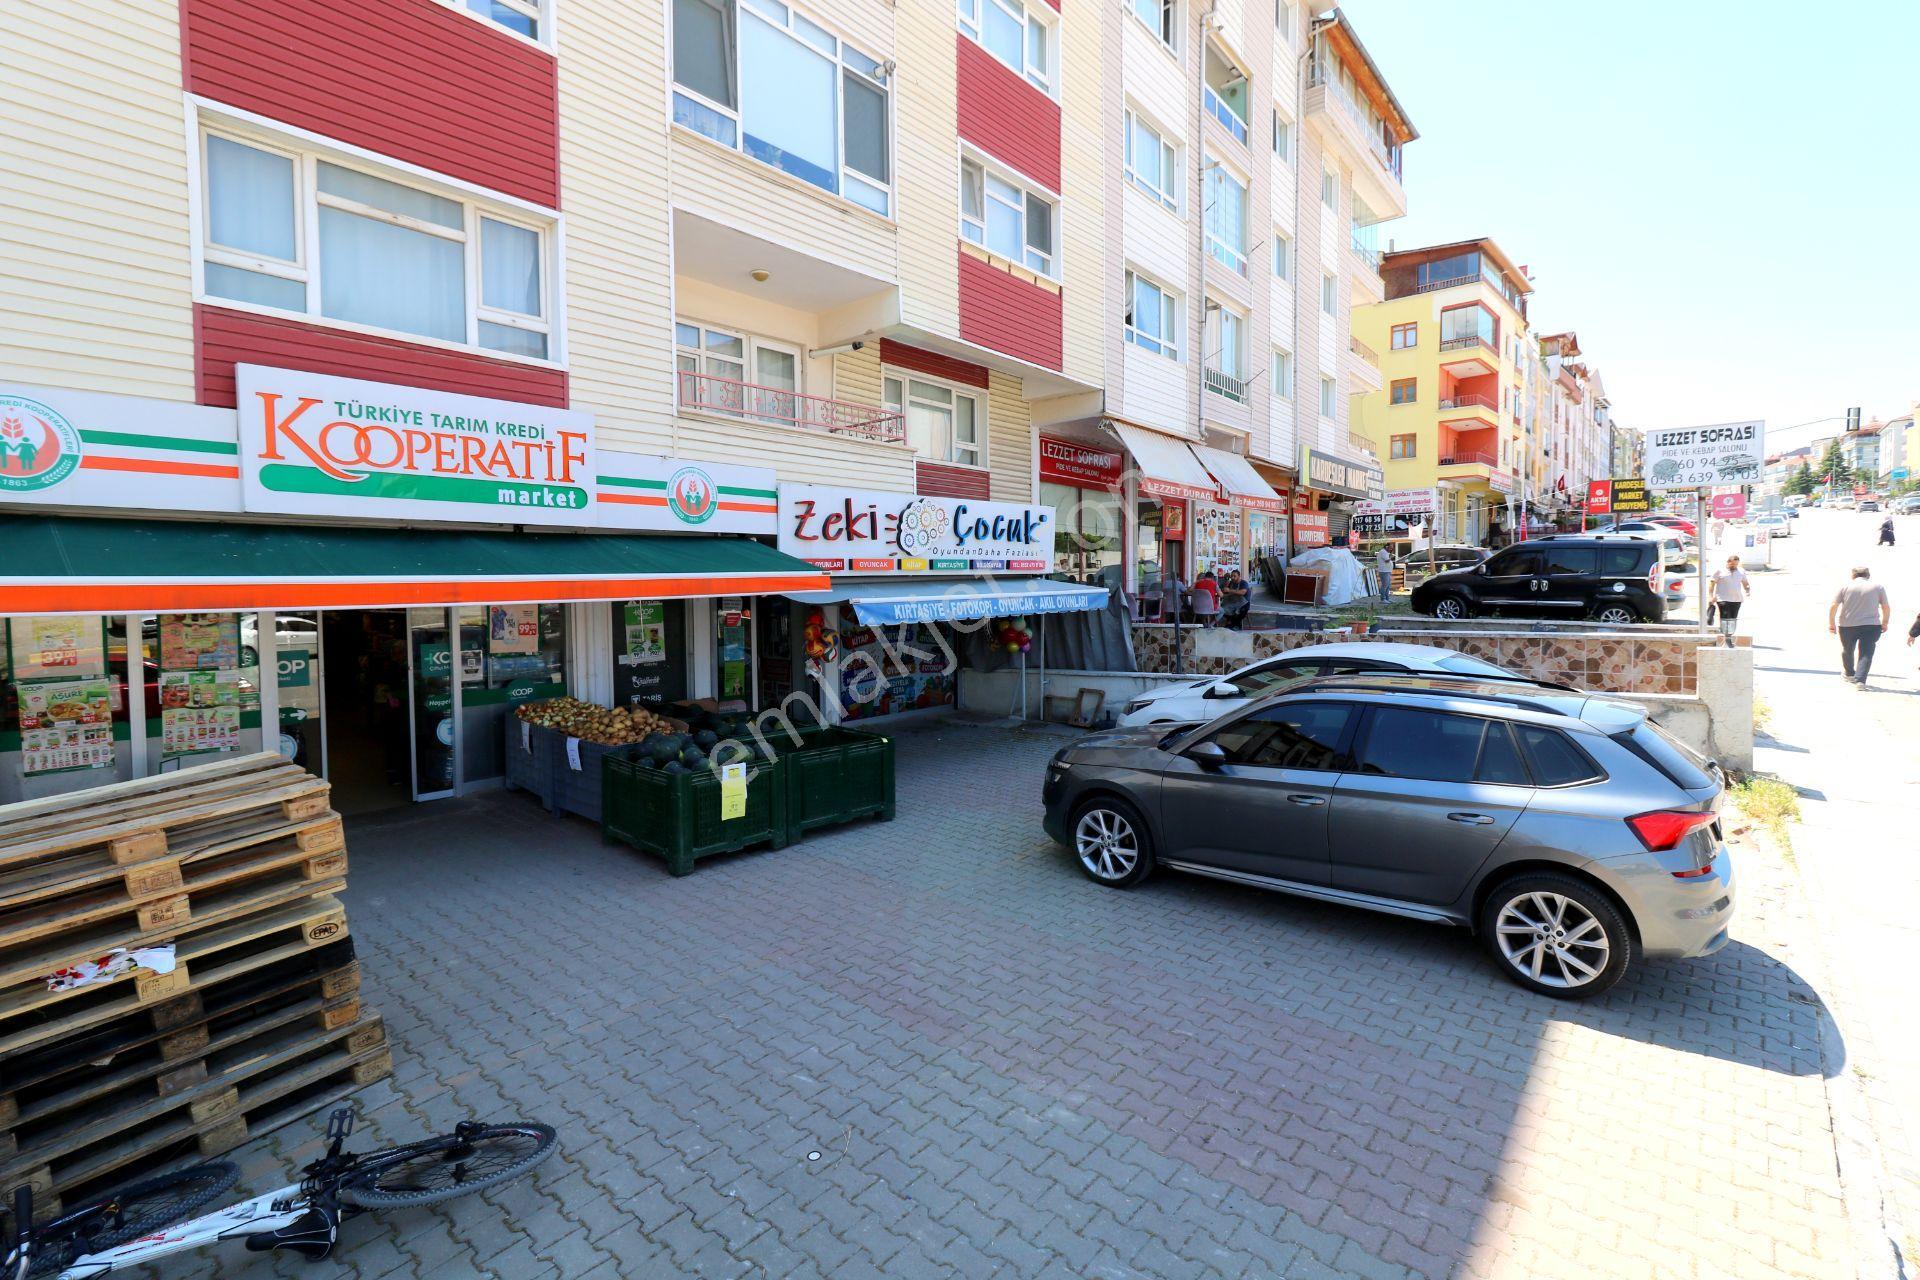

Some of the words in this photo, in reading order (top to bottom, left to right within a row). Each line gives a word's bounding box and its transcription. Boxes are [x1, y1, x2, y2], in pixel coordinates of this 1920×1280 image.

[334, 399, 423, 426] TÜRKİYE
[431, 413, 489, 434] TARIM
[495, 421, 545, 440] KREDİ
[255, 391, 587, 483] KOOPERATİF
[1655, 431, 1697, 447] LEZZET
[1700, 425, 1756, 443] SOFRASI
[1042, 442, 1075, 461] LEZZET
[1078, 450, 1111, 469] SOFRASI
[1681, 448, 1690, 456] VE
[1692, 447, 1716, 455] KEBAP
[1719, 444, 1748, 453] SALONU
[1700, 457, 1716, 467] 94
[1614, 481, 1645, 490] KARDEŞLE
[1688, 472, 1714, 483] 639
[498, 487, 576, 508] market
[1148, 482, 1181, 495] LEZZET
[1184, 488, 1213, 501] DURAĞI
[1618, 491, 1644, 500] MARKET
[1613, 499, 1649, 510] KURUYEMİŞ
[794, 498, 878, 541] Zeki
[953, 504, 1047, 546] Çocuk
[1000, 597, 1035, 612] OYUNCAK
[1039, 597, 1056, 609] AKIL
[1057, 595, 1089, 608] OYUNLARI
[519, 624, 529, 634] 99
[314, 926, 336, 937] EPAL
